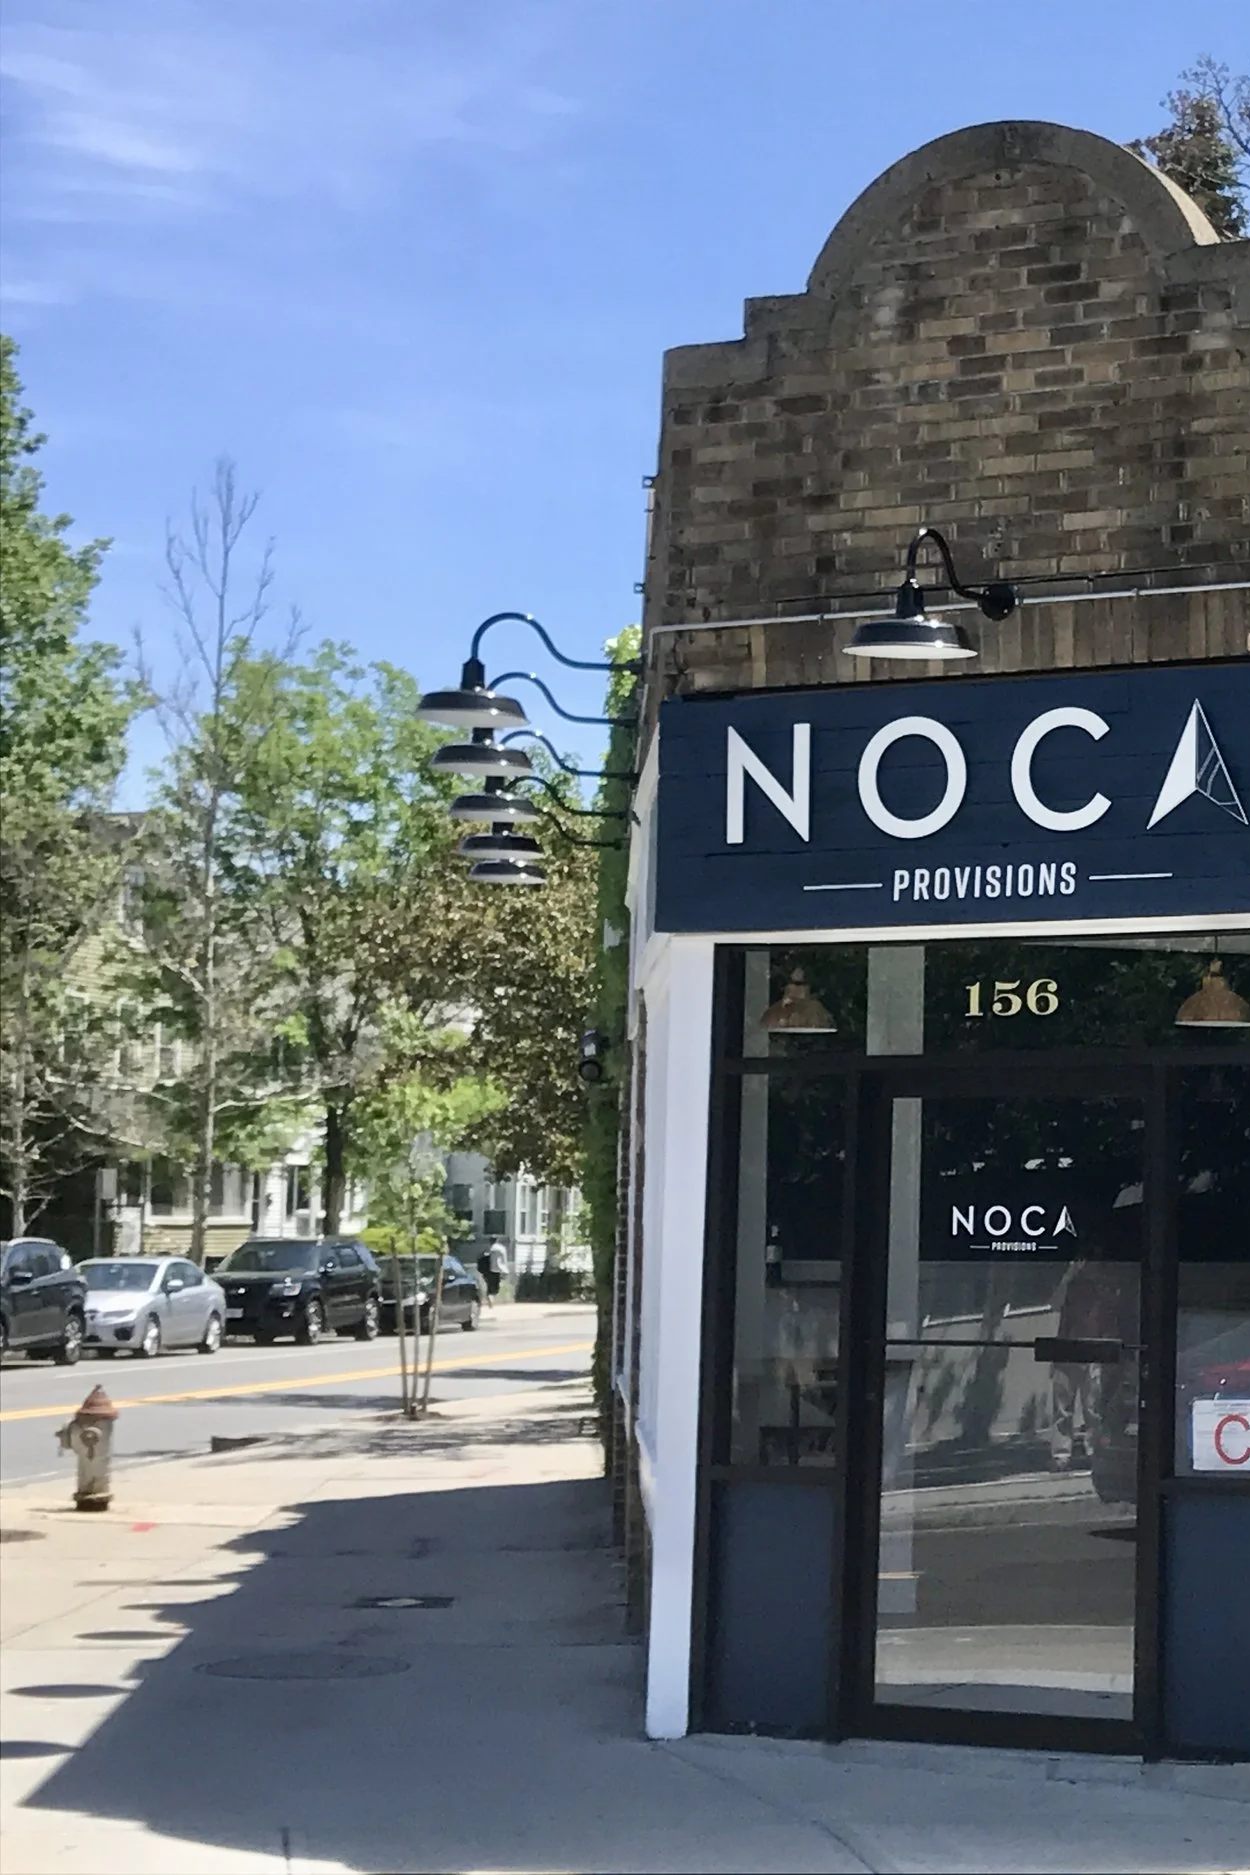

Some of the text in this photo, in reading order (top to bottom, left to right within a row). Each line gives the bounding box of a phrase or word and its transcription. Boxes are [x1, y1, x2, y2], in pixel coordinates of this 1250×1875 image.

[726, 697, 1250, 846] NOCA
[893, 862, 1078, 902] PROVISIONS
[964, 978, 1060, 1017] 156
[952, 1205, 1078, 1237] NOCA
